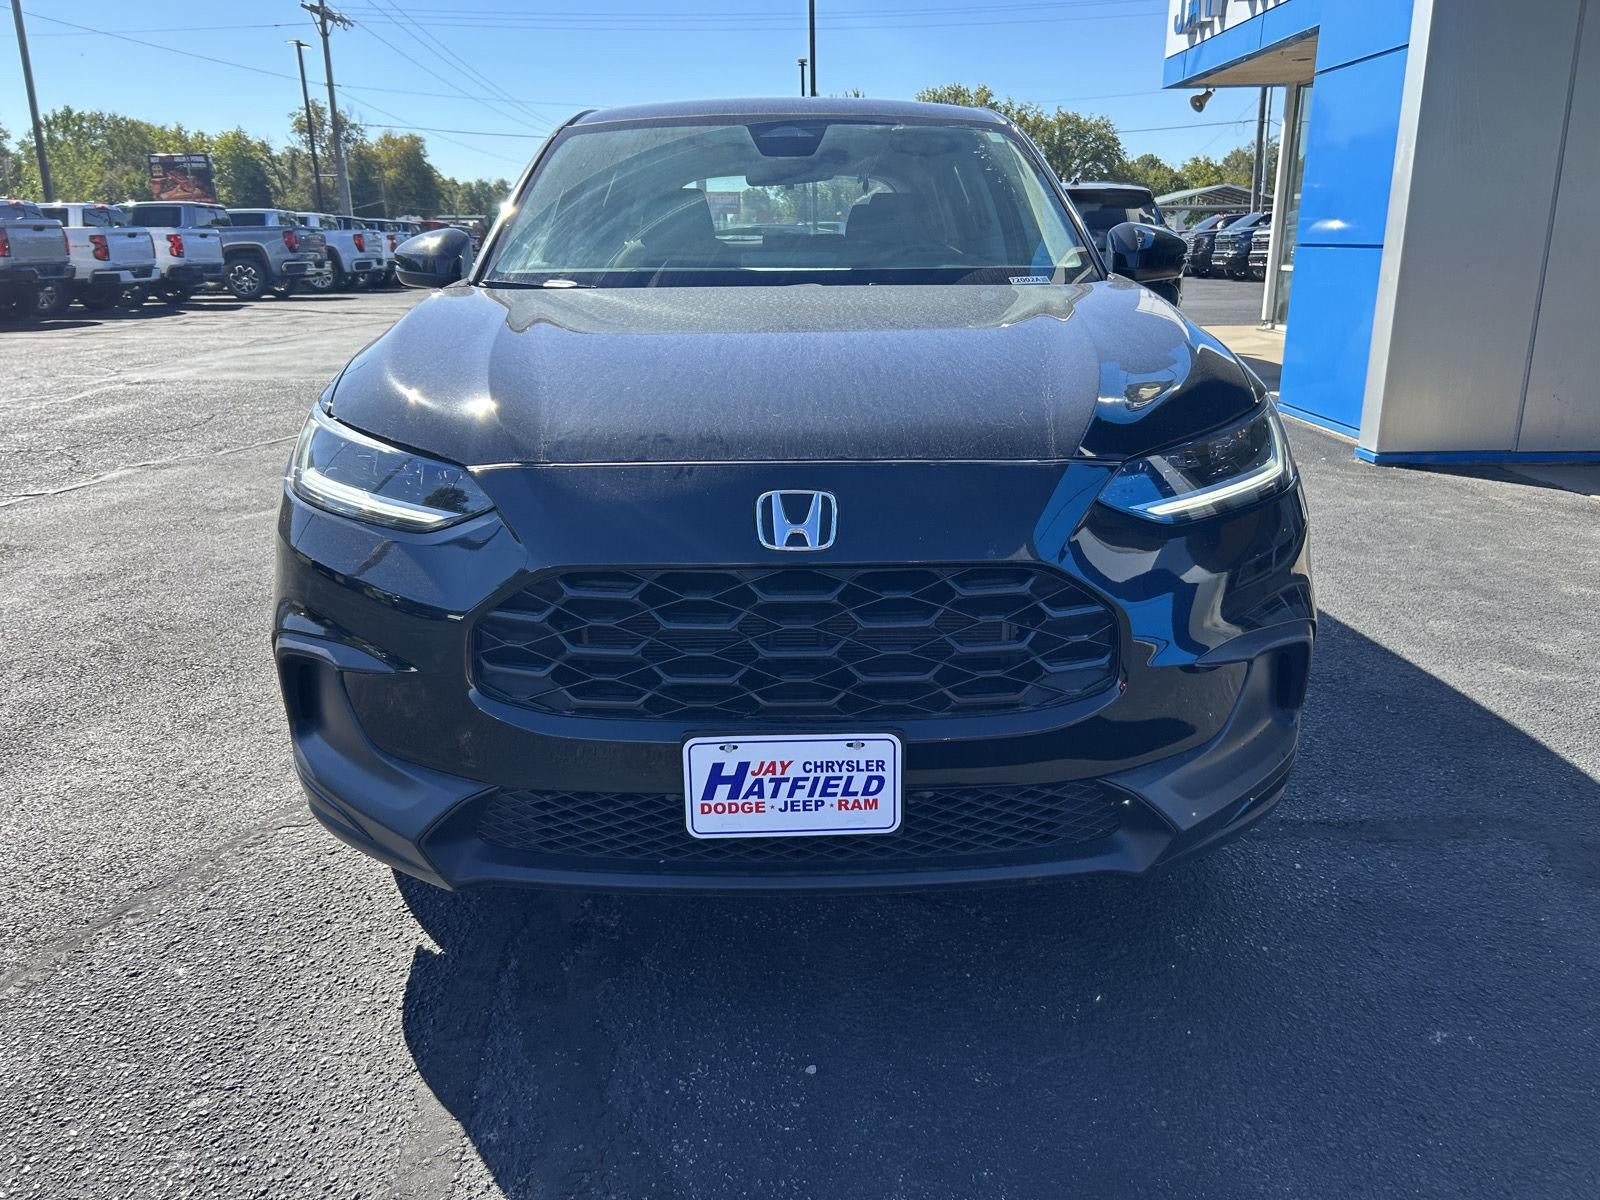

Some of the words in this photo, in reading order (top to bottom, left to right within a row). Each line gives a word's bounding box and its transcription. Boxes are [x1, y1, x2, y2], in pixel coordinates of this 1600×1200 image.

[750, 760, 795, 776] JAY
[802, 759, 886, 774] CHRYSLER
[701, 760, 886, 801] HATFIELD
[700, 801, 766, 815] DODGE
[778, 799, 826, 813] JEEP
[837, 798, 879, 811] RAM
